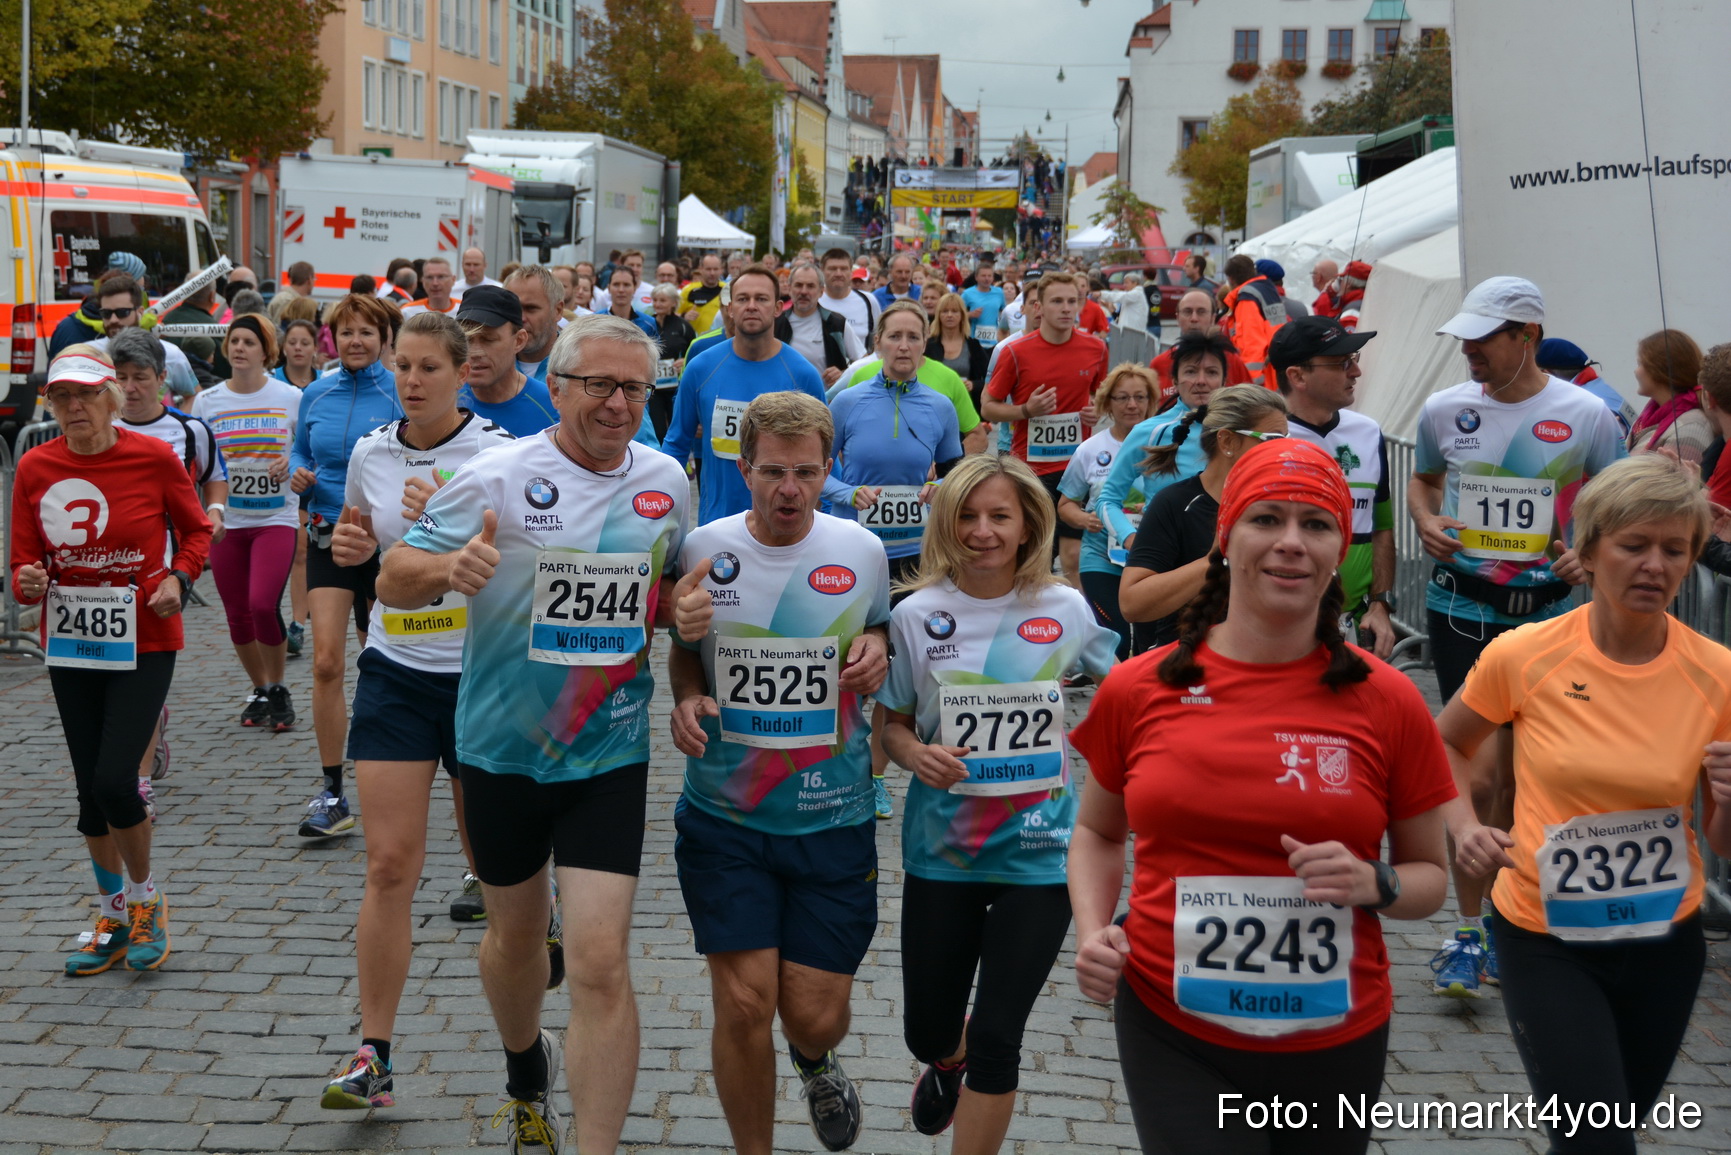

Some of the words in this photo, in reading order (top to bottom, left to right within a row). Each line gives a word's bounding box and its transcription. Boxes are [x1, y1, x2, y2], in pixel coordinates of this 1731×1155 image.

[931, 194, 975, 205] START
[361, 207, 421, 220] Bayerisches
[360, 220, 389, 230] Rotes
[360, 232, 389, 243] Kreuz
[976, 330, 996, 340] 2027
[244, 417, 259, 429] BEI
[261, 417, 279, 429] MIR
[1030, 418, 1047, 426] PARTL
[1033, 425, 1077, 445] 2049
[1537, 425, 1568, 438] Hervis
[1041, 447, 1069, 457] Bastian
[228, 466, 247, 474] PARTL
[405, 457, 436, 468] hummel
[232, 475, 281, 495] 2299
[1461, 482, 1489, 493] PARTL
[1491, 485, 1538, 495] Neumarkt
[637, 497, 671, 513] Hervis
[865, 500, 923, 525] 2699
[1477, 496, 1535, 529] 119
[62, 497, 101, 546] 3
[524, 514, 563, 525] PARTL
[524, 524, 564, 532] Neumarkt
[877, 530, 909, 540] Andrea
[1478, 533, 1527, 550] Thomas
[539, 562, 581, 575] PARTL
[583, 564, 634, 576] Neumarkt
[815, 572, 852, 587] Hervis
[76, 594, 120, 604] Neumarkt
[545, 578, 640, 622] 2544
[56, 606, 128, 639] 2485
[402, 615, 454, 632] Martina
[1023, 624, 1060, 638] Hervis
[556, 630, 625, 653] Wolfgang
[75, 643, 106, 658] Heidi
[717, 646, 757, 659] PARTL
[760, 648, 818, 659] Neumarkt
[926, 644, 960, 656] PARTL
[728, 663, 828, 706] 2525
[612, 687, 630, 708] 16.
[943, 695, 985, 707] PARTL
[987, 693, 1044, 706] Neumarkt
[1180, 695, 1213, 705] erima
[1563, 690, 1591, 702] erima
[751, 715, 803, 734] Rudolf
[954, 707, 1054, 753] 2722
[1273, 732, 1297, 743] TSV
[1299, 734, 1350, 747] Wolfstein
[976, 762, 1036, 781] Justyna
[800, 771, 827, 789] 16.
[798, 784, 853, 800] Neumarkter
[796, 797, 843, 812] Stadtlauf
[1021, 809, 1049, 828] 16.
[1019, 826, 1073, 840] Neumarkter
[1587, 819, 1658, 838] Neumarkt
[1019, 837, 1069, 851] Stadtlauf
[1551, 835, 1678, 894] 2322
[1180, 891, 1239, 907] PARTL
[1606, 901, 1637, 921] Evi
[1194, 915, 1339, 975] 2243
[1228, 988, 1304, 1014] Karola
